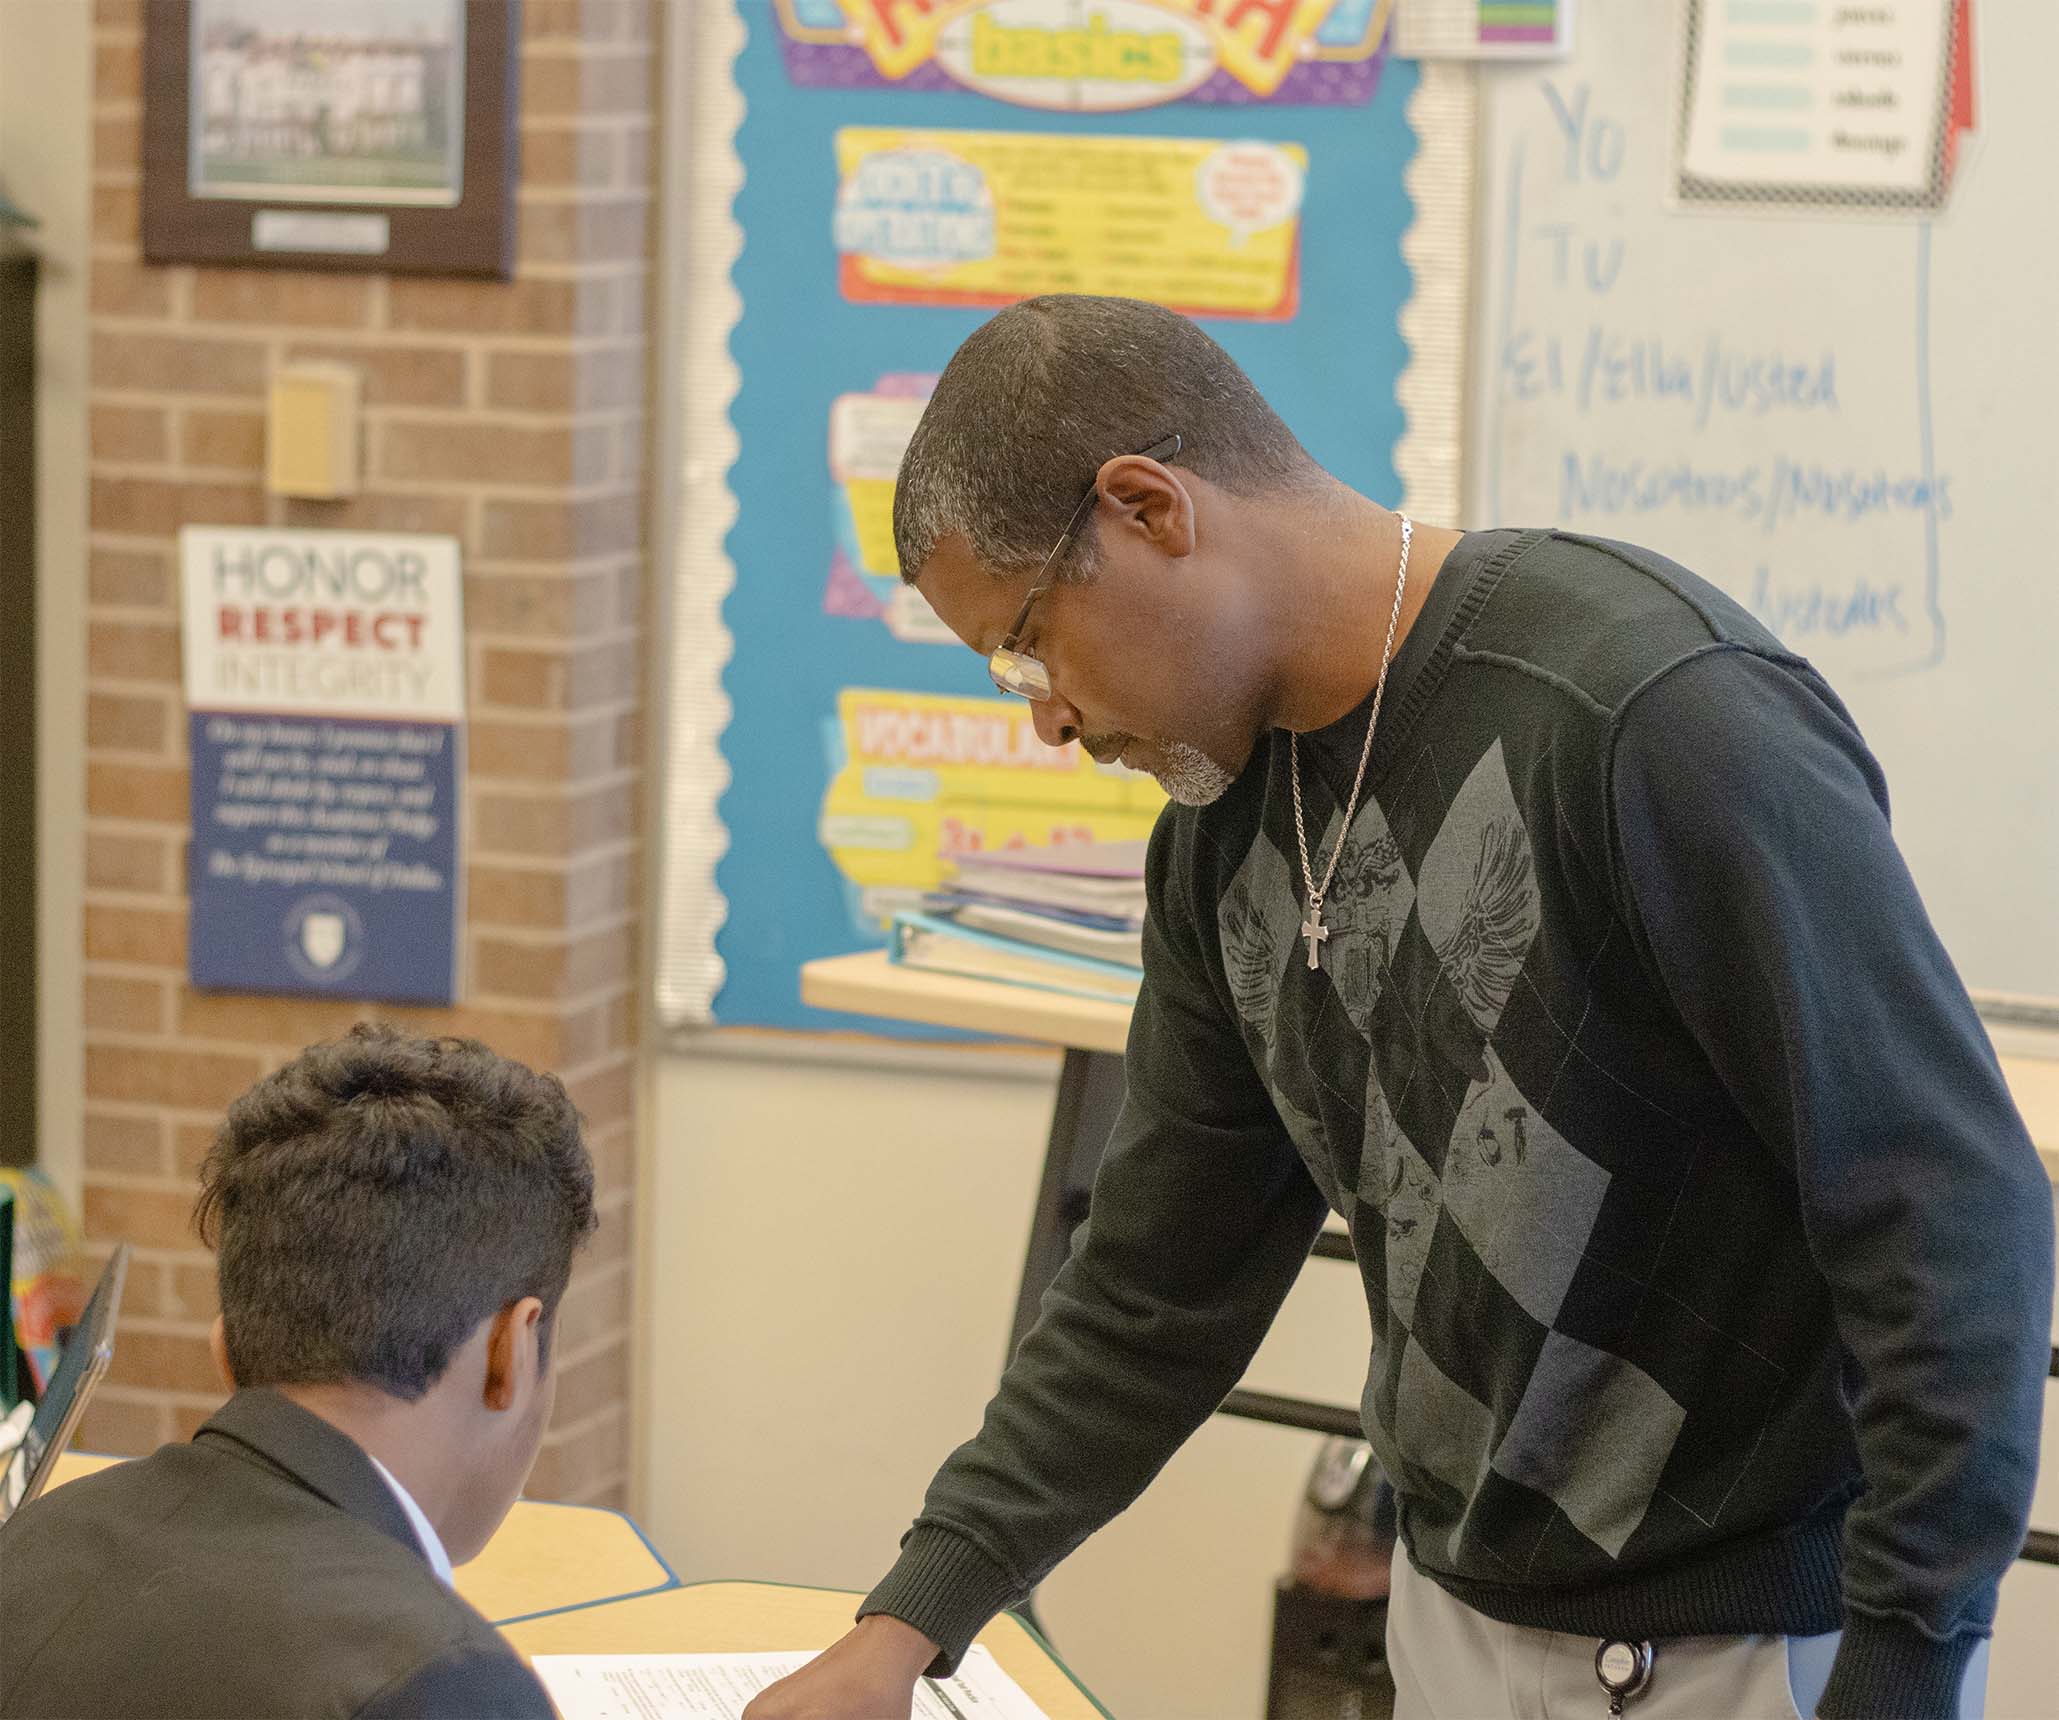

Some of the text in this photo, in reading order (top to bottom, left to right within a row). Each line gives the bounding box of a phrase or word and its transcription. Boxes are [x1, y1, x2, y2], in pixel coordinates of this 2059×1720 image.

[972, 12, 1184, 80] basics
[212, 543, 428, 603] HONOR
[215, 606, 428, 653] RESPECT
[214, 655, 432, 700] INTEGRITY
